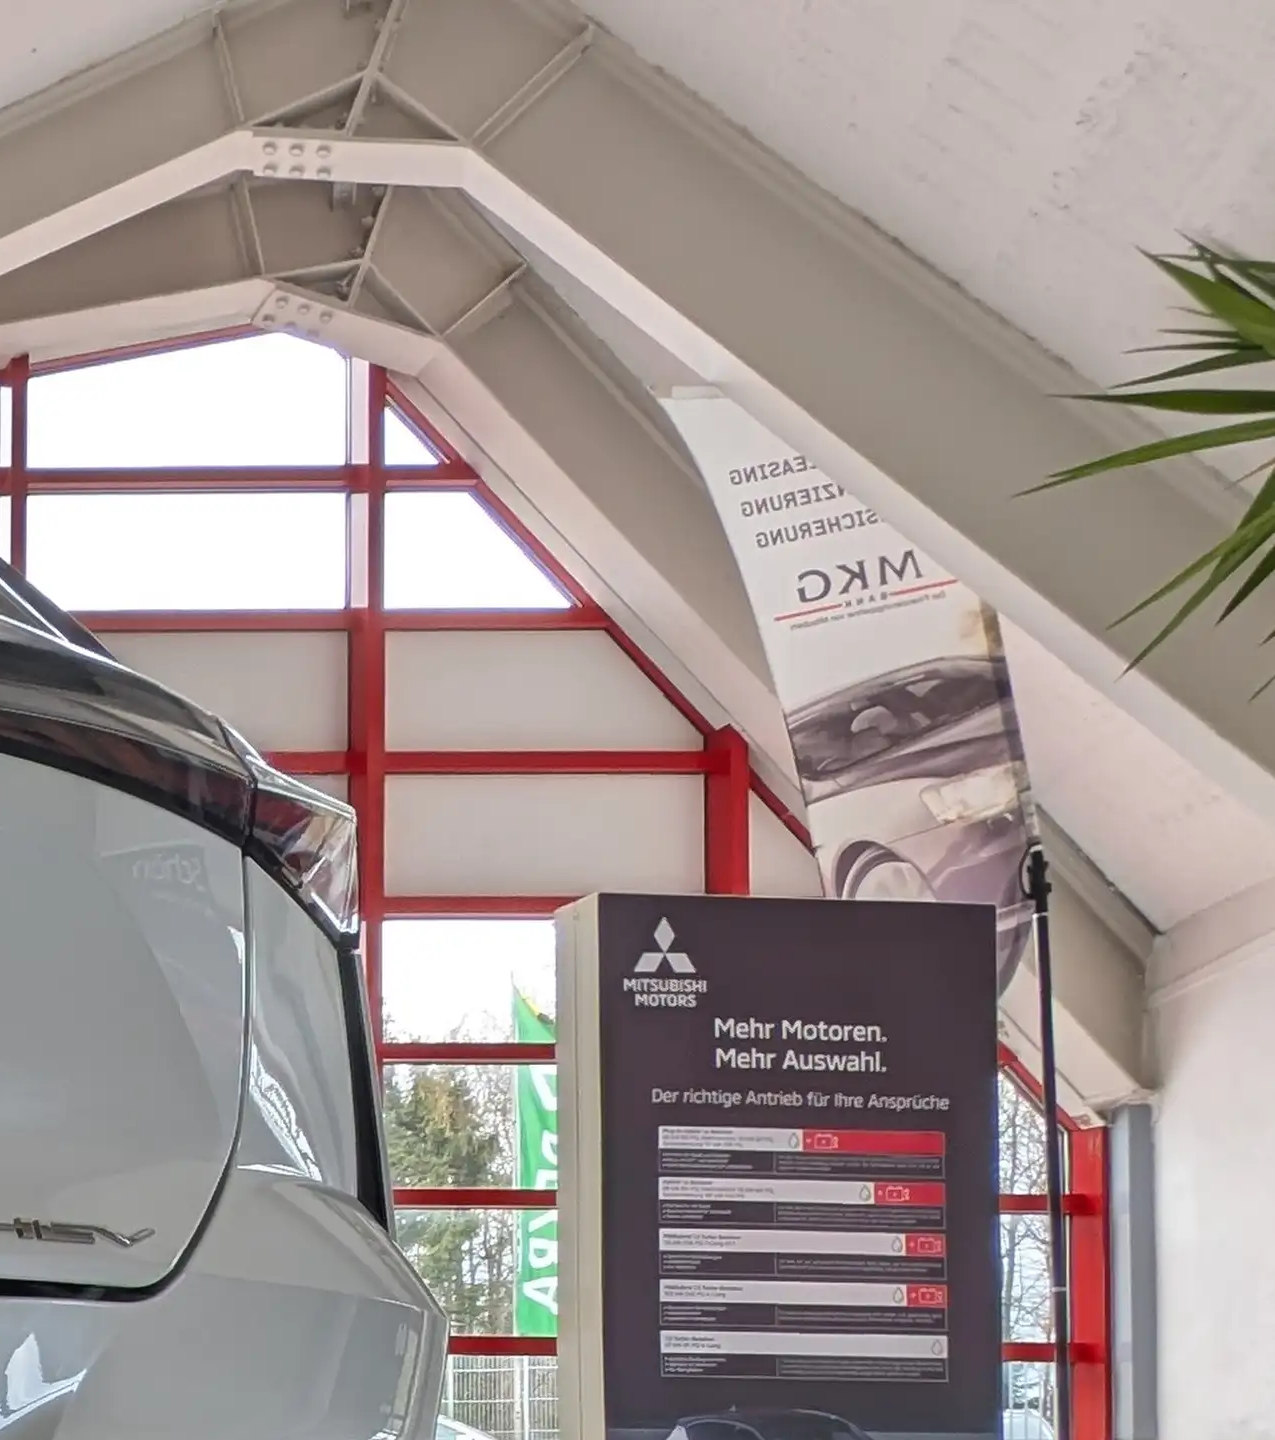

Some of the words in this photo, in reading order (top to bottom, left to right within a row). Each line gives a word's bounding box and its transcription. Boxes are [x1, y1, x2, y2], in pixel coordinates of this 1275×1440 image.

[623, 978, 707, 993] MITSUBISHI
[634, 993, 697, 1007] MOTORS
[714, 1018, 775, 1040] Mehr
[781, 1020, 888, 1043] Motoren.
[715, 1048, 776, 1070] Mehr
[782, 1050, 887, 1073] Auswahl.
[651, 1088, 679, 1103] Der
[683, 1089, 742, 1108] richtige
[745, 1090, 803, 1107] Antrieb
[807, 1091, 828, 1107] für
[834, 1092, 863, 1108] Ihre
[867, 1093, 950, 1112] Ansprüche
